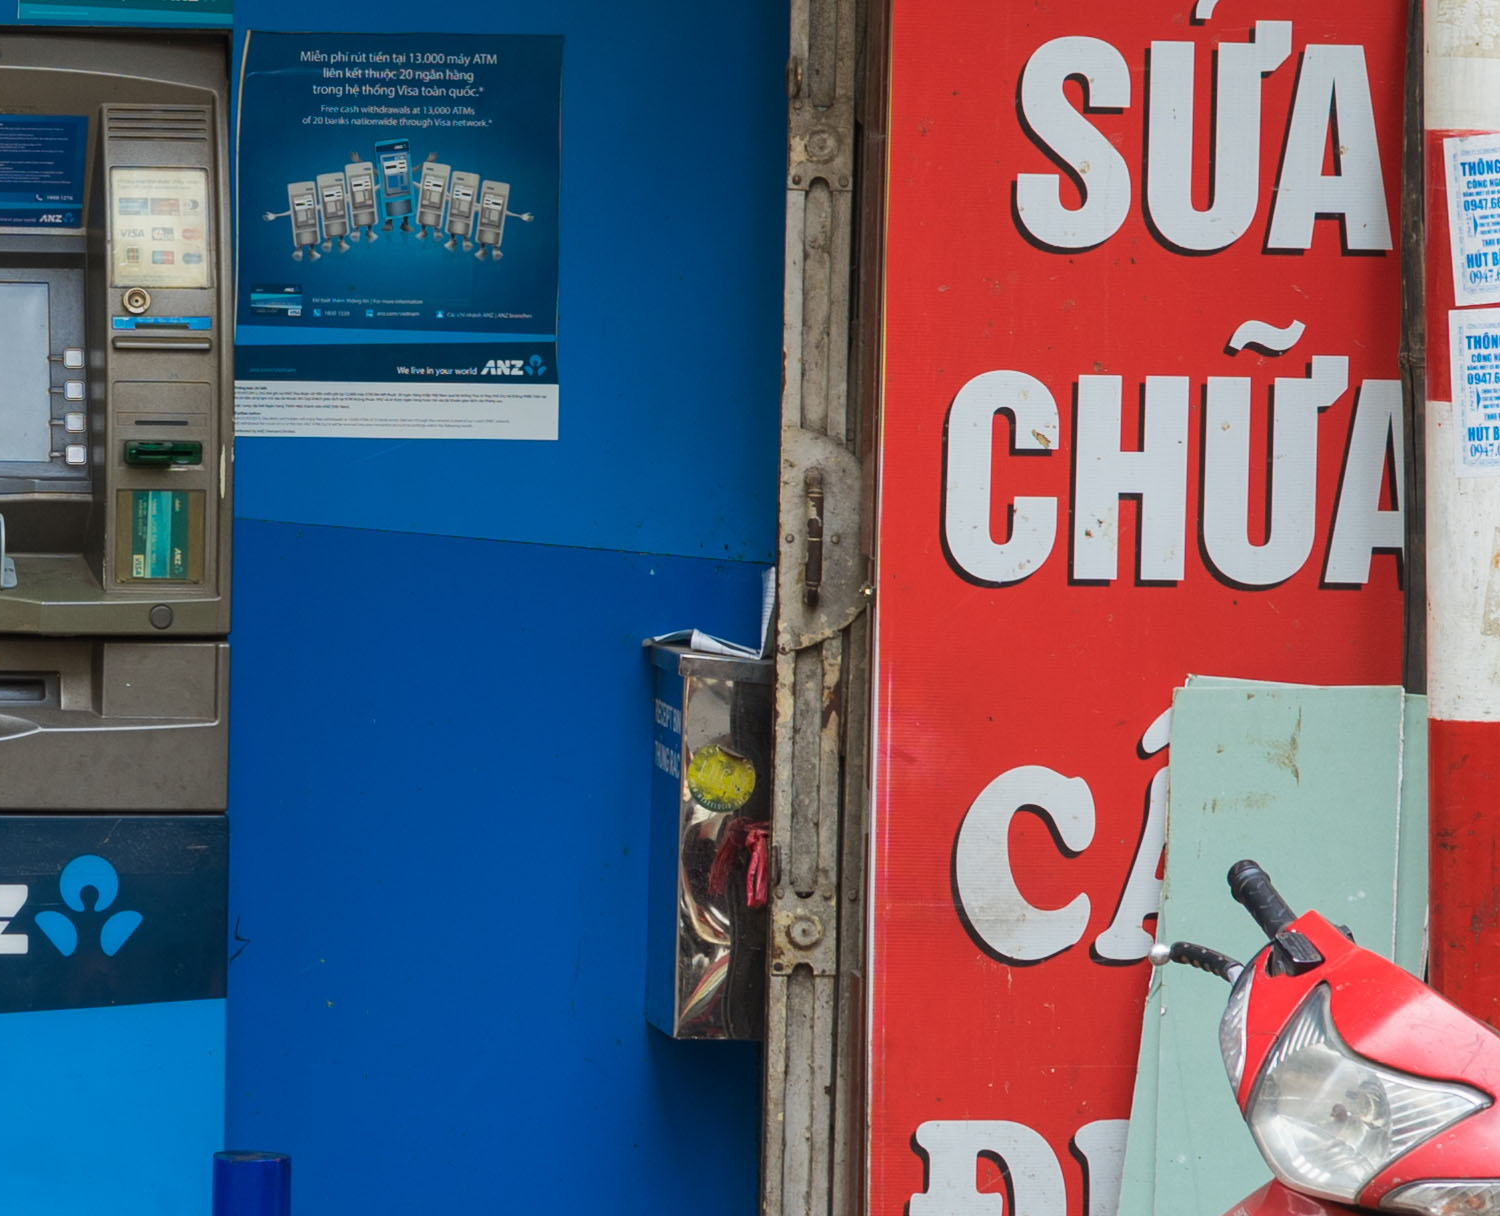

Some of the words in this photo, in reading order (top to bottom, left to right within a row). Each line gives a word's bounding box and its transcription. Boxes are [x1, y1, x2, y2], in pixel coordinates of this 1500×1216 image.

[300, 50, 328, 63] Miễn
[330, 51, 349, 66] phí
[351, 51, 366, 63] rút
[409, 53, 445, 64] 13.000
[472, 54, 497, 65] ATM
[323, 67, 343, 79] liên
[399, 69, 413, 80] 20
[446, 69, 474, 83] hàng
[313, 84, 343, 98] trong
[397, 85, 419, 97] Visa
[421, 85, 446, 97] toàn
[320, 105, 339, 114] Free
[340, 105, 358, 114] cash
[361, 105, 410, 115] withdrawals
[423, 106, 450, 116] 13,000
[452, 106, 475, 116] ATMs
[312, 116, 323, 125] 20
[351, 116, 398, 127] nationwide
[399, 117, 433, 129] through
[434, 118, 451, 127] Visa
[39, 214, 63, 223] ANZ
[1466, 249, 1488, 269] HÚT
[397, 366, 410, 375] We
[411, 366, 425, 375] live
[426, 367, 434, 375] in
[435, 368, 454, 377] your
[455, 367, 478, 376] world
[480, 359, 524, 376] ANZ
[1467, 423, 1490, 442] HÚT
[945, 319, 1405, 587] CHỮA
